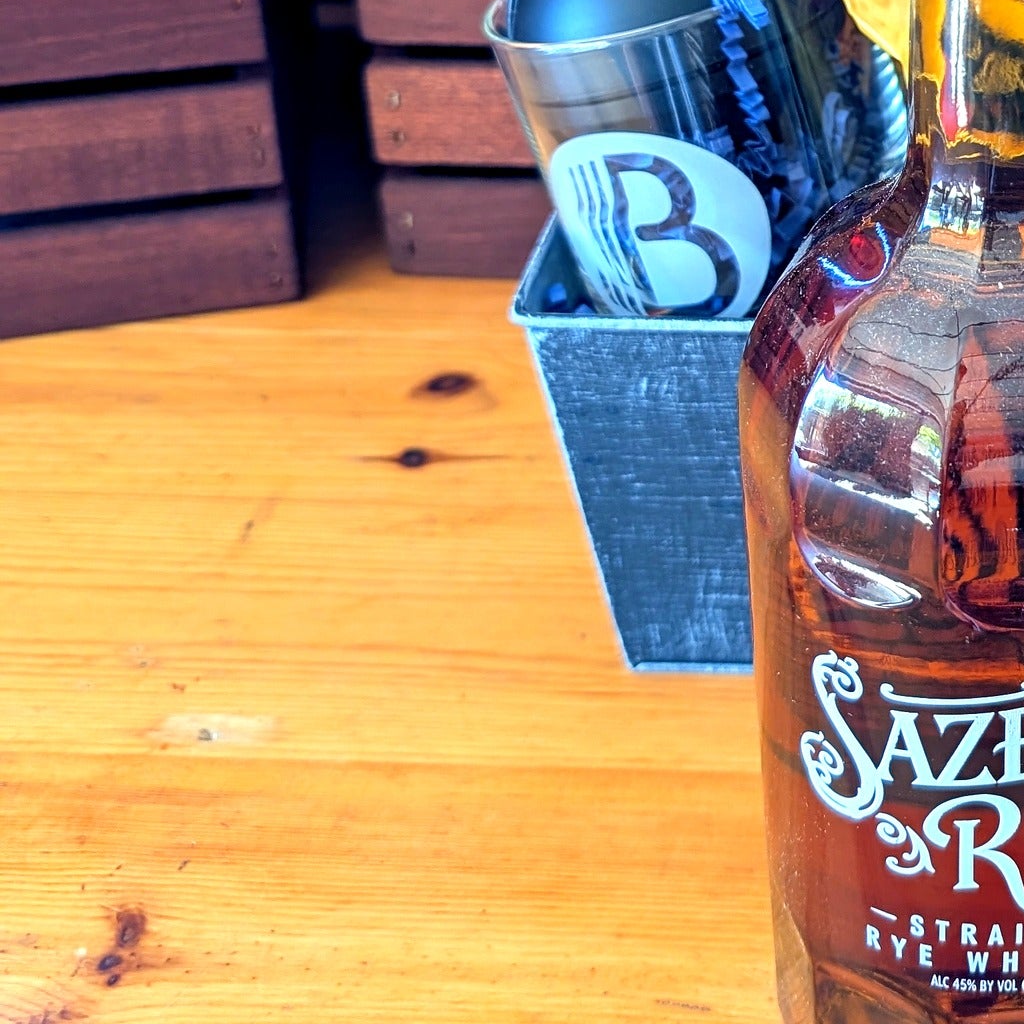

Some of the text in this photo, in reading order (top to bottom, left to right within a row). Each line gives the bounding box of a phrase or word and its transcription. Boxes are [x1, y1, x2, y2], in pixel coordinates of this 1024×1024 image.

[866, 923, 934, 967] RYE
[930, 973, 950, 990] ALC
[952, 977, 977, 992] 45%
[979, 979, 994, 993] BY
[997, 978, 1018, 992] VOL
